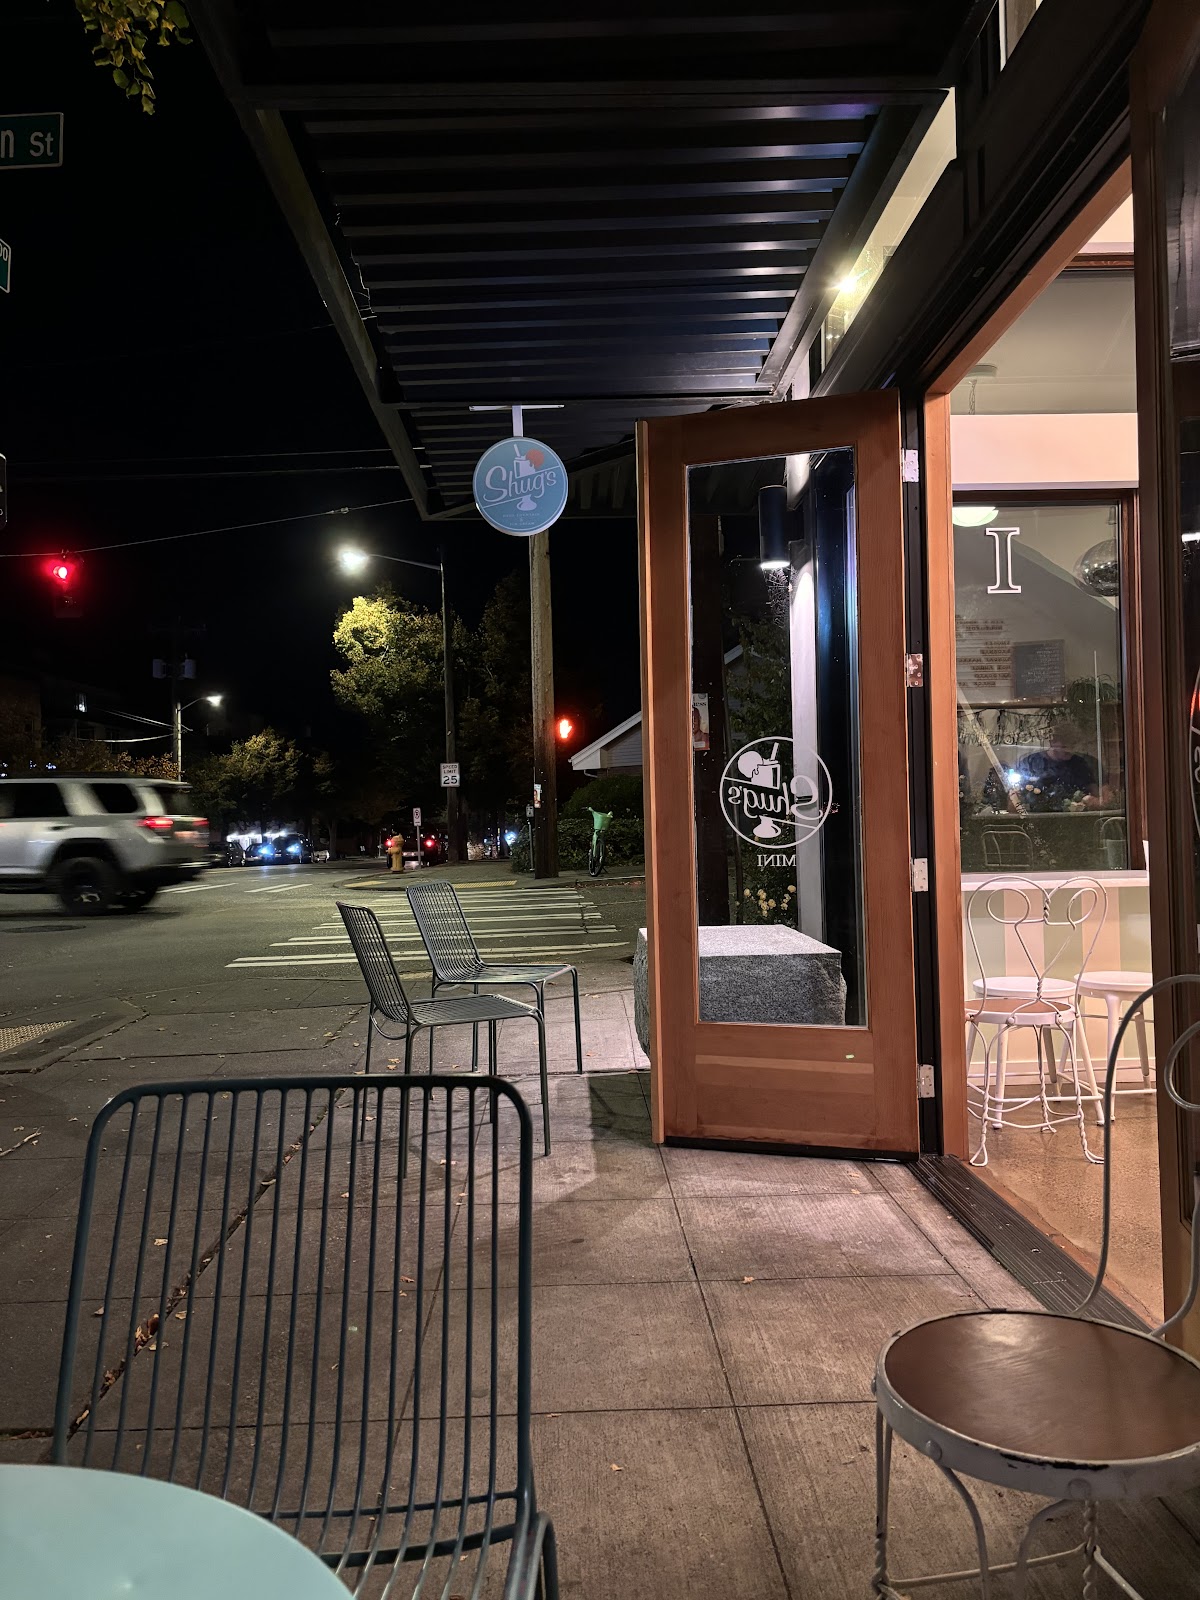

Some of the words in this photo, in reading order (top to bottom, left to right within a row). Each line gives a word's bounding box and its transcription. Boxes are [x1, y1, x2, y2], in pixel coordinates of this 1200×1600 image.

[29, 131, 54, 157] St
[482, 465, 557, 503] Shug's
[442, 775, 458, 785] 25
